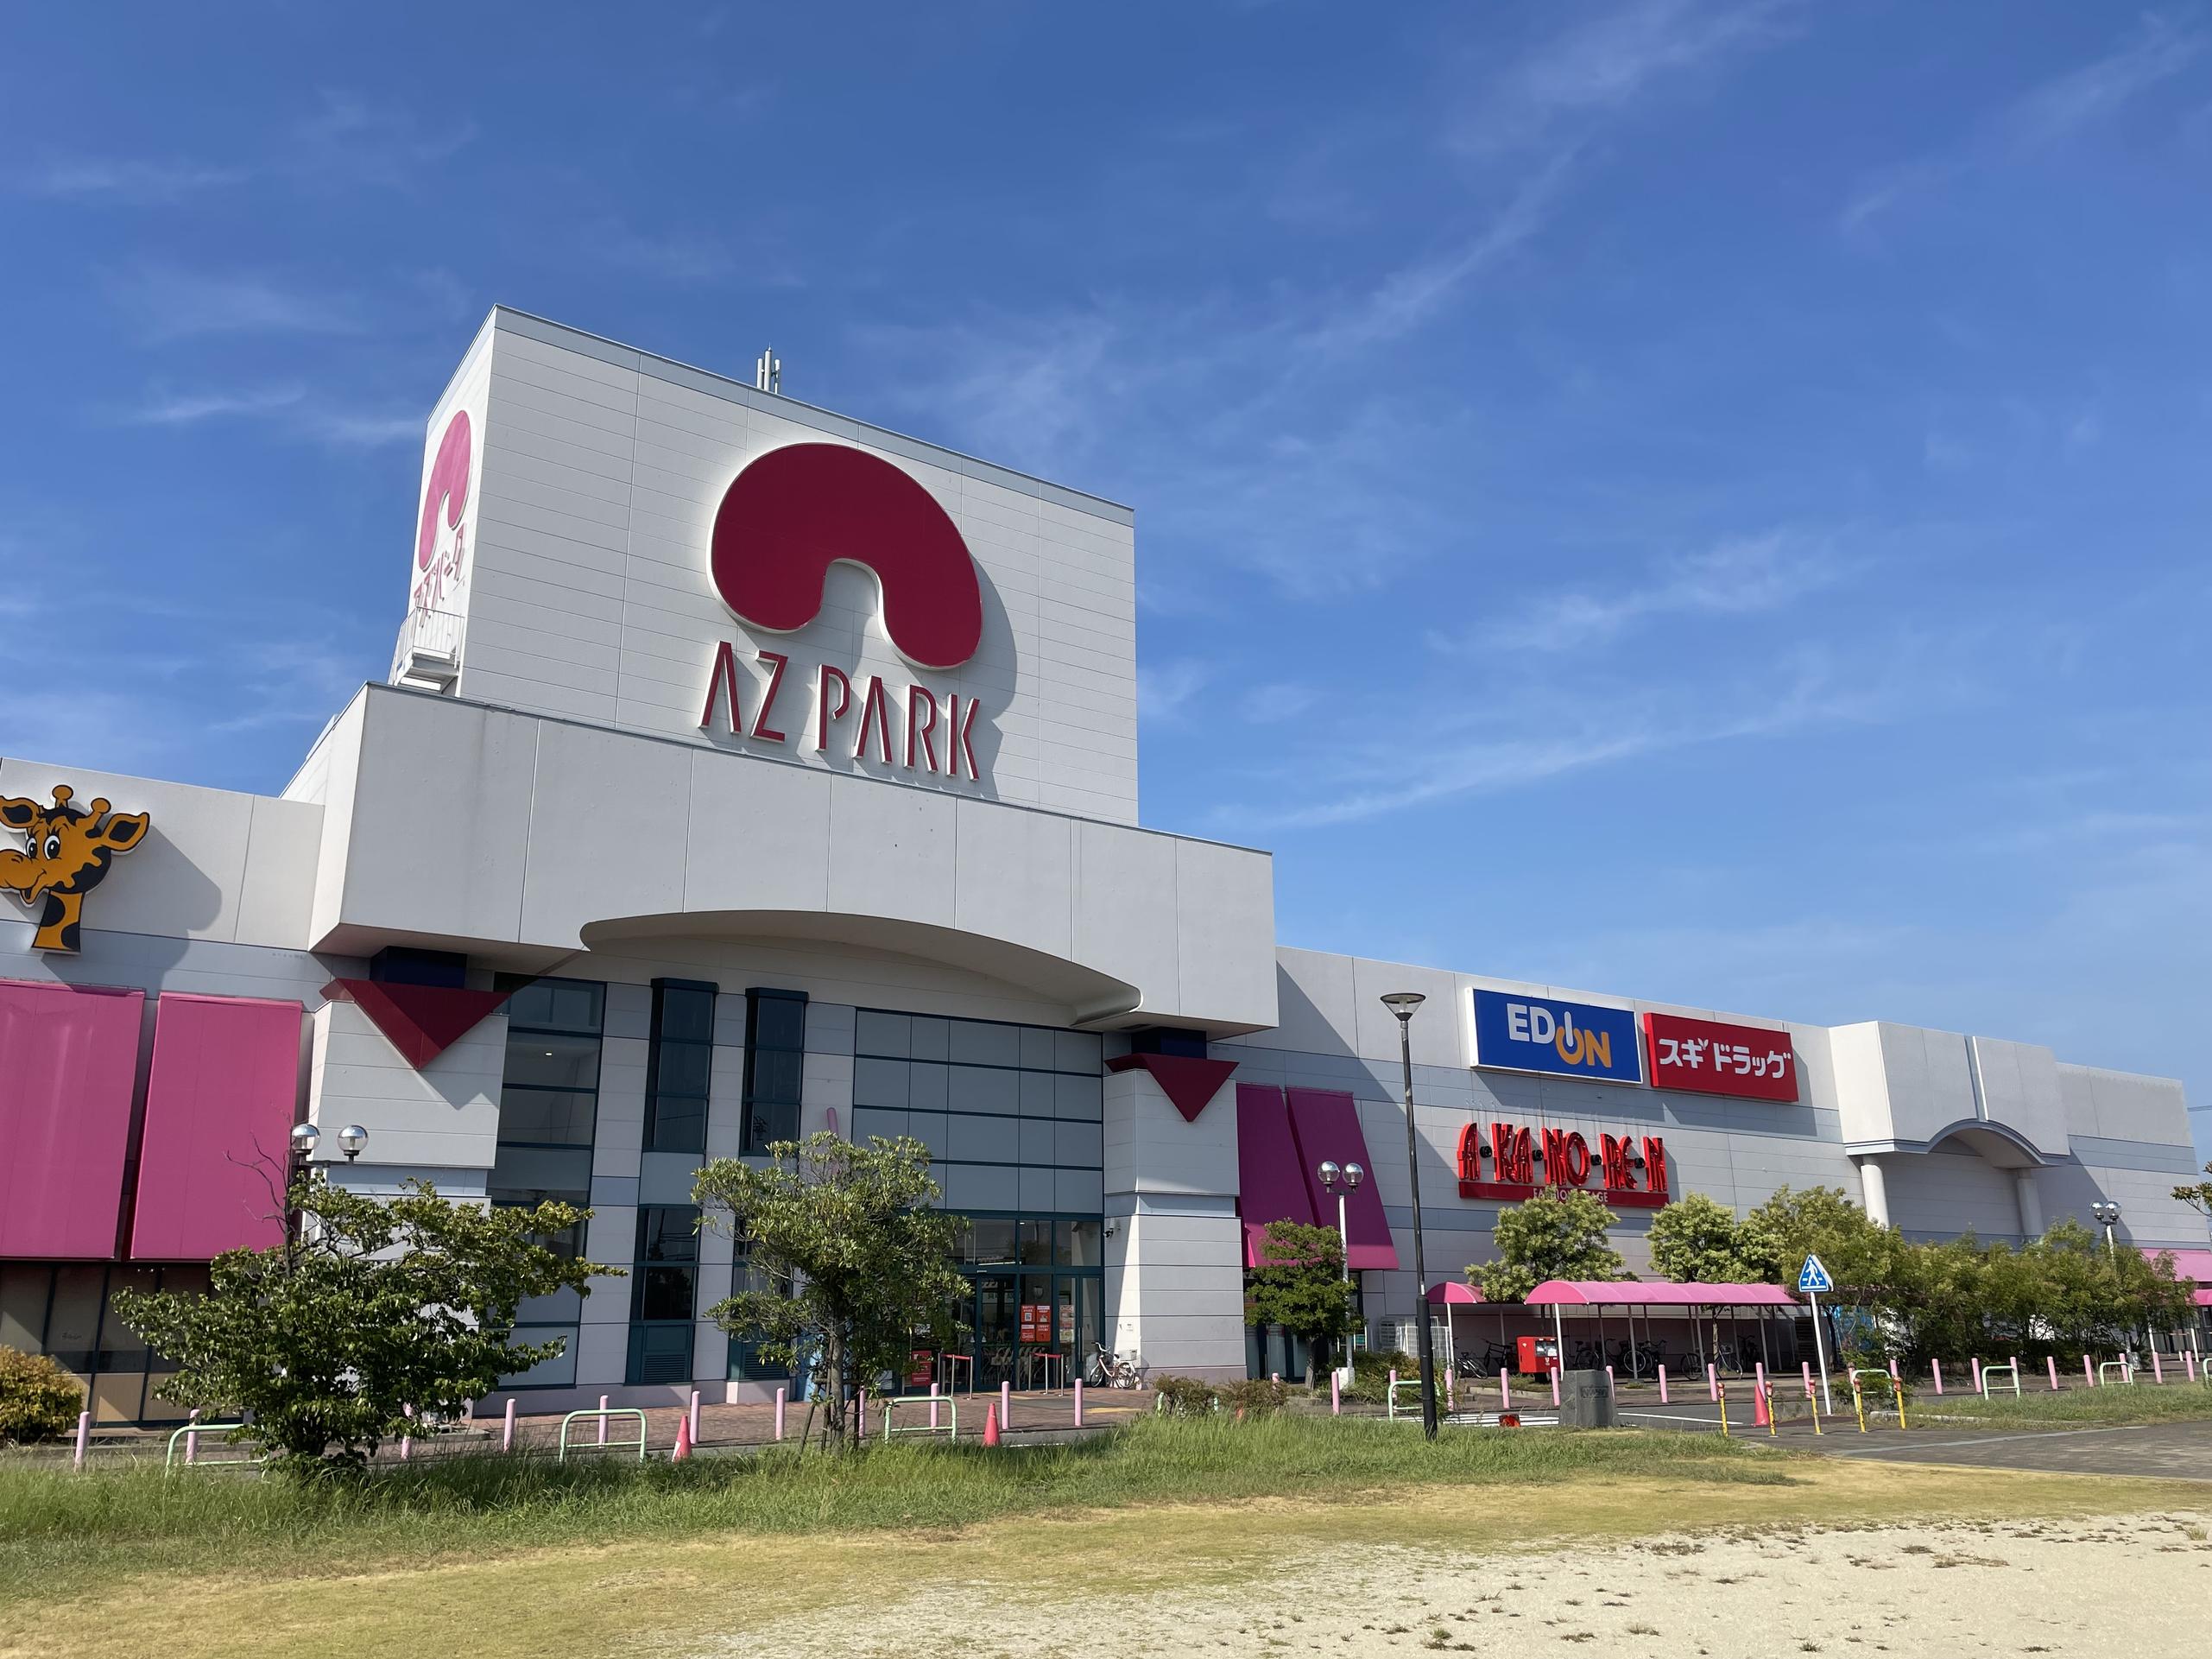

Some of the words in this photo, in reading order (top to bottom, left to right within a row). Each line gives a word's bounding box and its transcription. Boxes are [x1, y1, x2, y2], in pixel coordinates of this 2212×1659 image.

[698, 641, 788, 742] AZ
[815, 664, 980, 781] PARK
[1507, 1003, 1612, 1068] EDION
